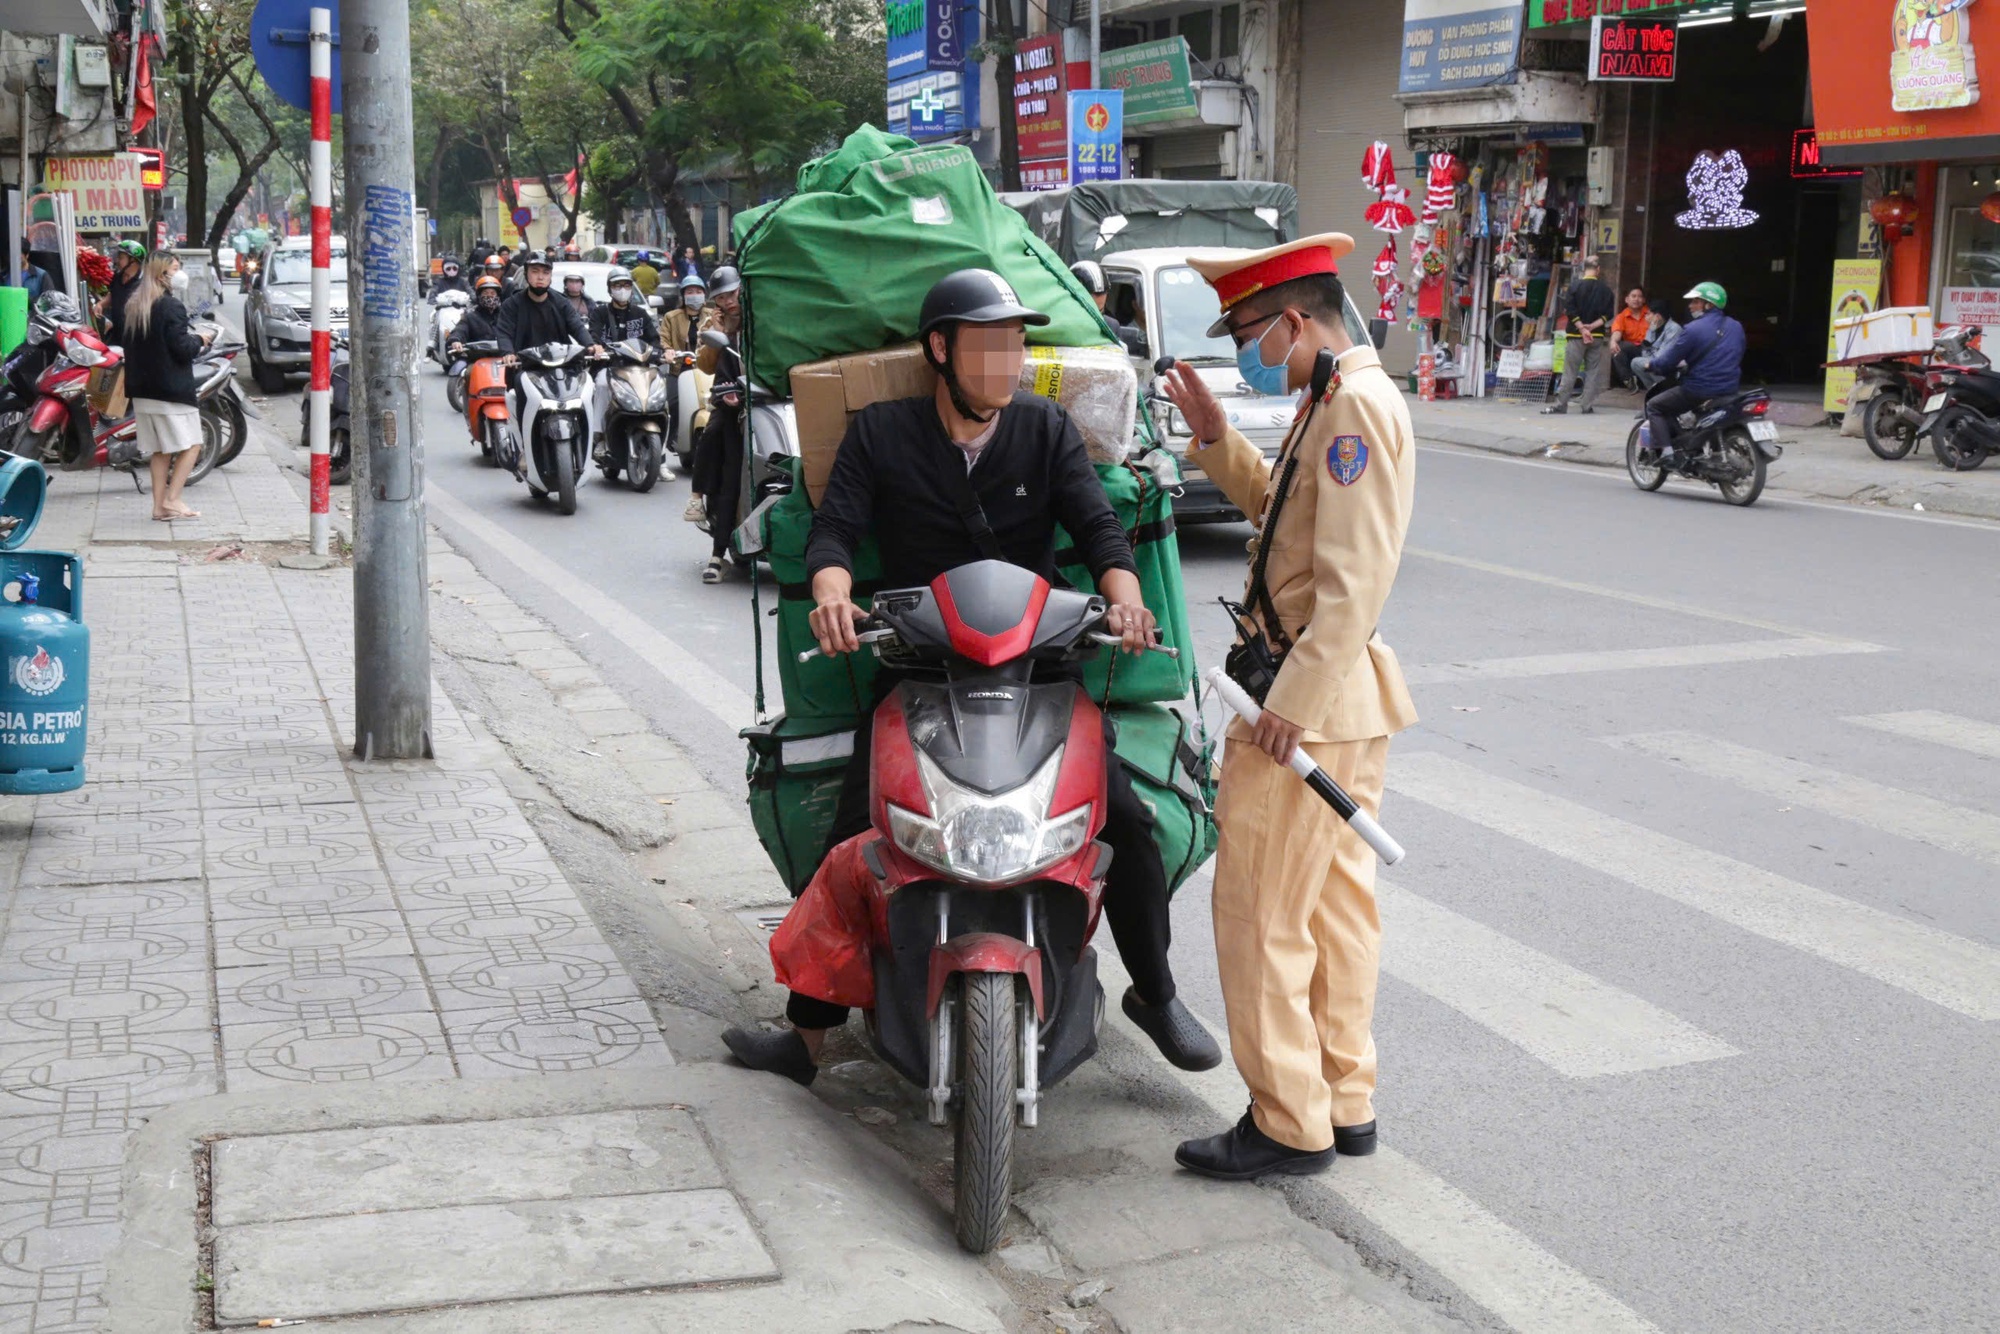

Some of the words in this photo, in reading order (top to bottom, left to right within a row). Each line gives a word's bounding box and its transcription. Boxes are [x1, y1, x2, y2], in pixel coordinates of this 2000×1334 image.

[1603, 21, 1637, 50] CẮT
[1641, 24, 1674, 52] TÓC
[1492, 40, 1513, 55] SINH
[1483, 61, 1506, 77] KHOA
[1601, 53, 1673, 77] NAM
[1079, 143, 1116, 163] 22-12
[49, 157, 135, 182] PHOTOCOPY
[1101, 165, 1117, 174] 2025
[86, 184, 139, 211] MÀU
[101, 215, 141, 228] TRUNG
[1047, 363, 1062, 402] HOUSE
[968, 691, 1013, 700] HONDA
[33, 710, 81, 730] PETRO
[2, 733, 17, 745] 12
